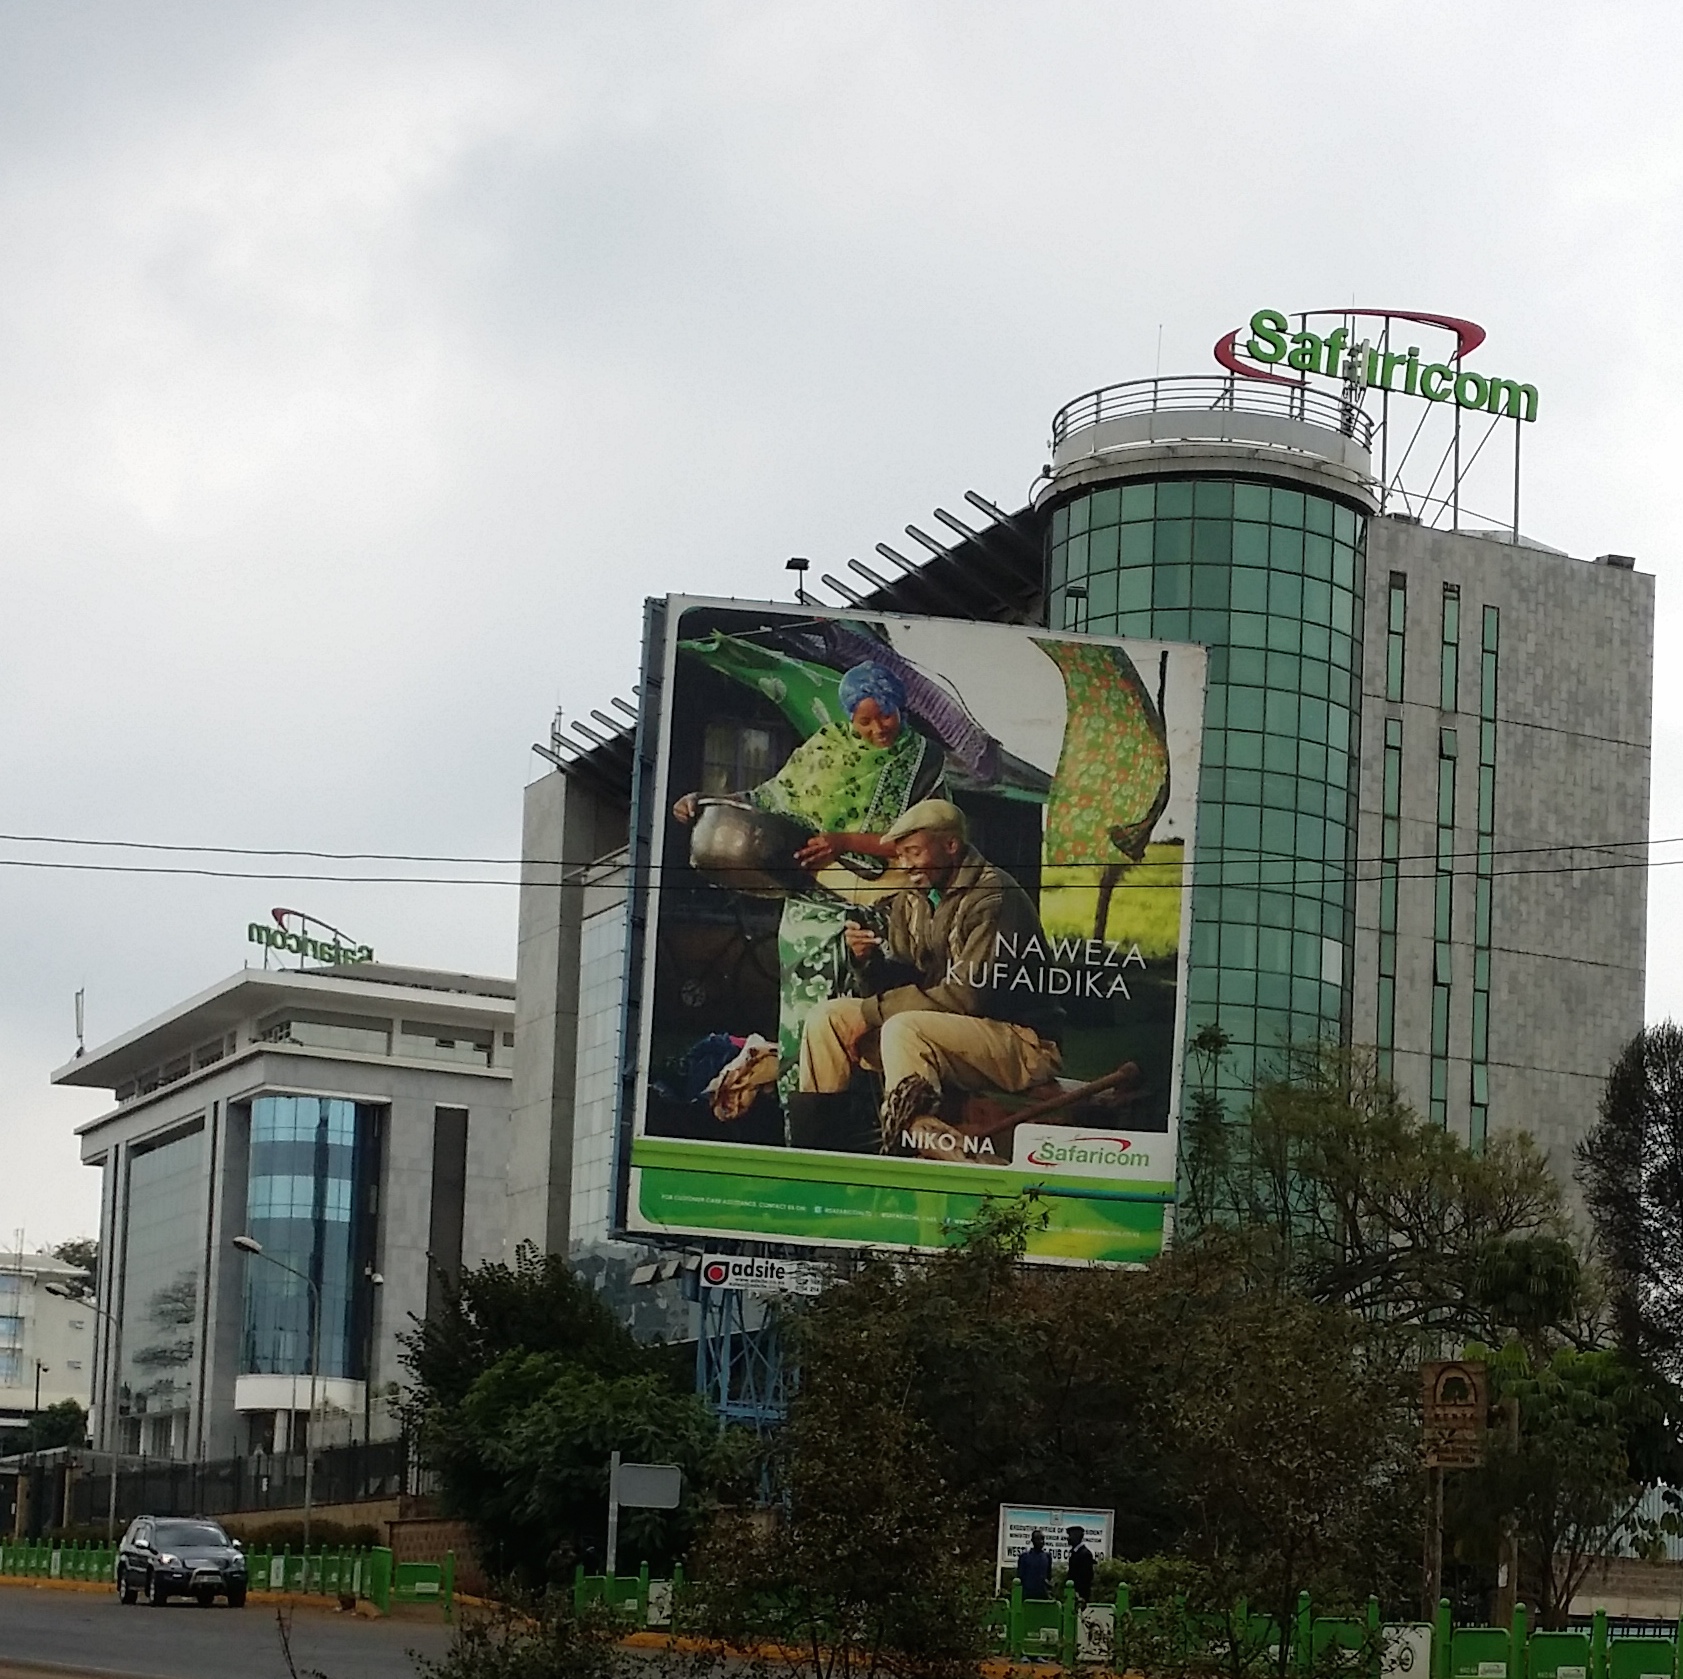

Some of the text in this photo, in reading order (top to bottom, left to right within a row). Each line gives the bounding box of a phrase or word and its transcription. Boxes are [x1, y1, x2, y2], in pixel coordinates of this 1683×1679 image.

[995, 931, 1147, 970] NAWEZA
[945, 959, 1131, 1000] KUFAIDIKA
[901, 1130, 996, 1155] NIKO NA
[1039, 1142, 1150, 1167] Safaricom
[731, 1258, 785, 1279] adsite
